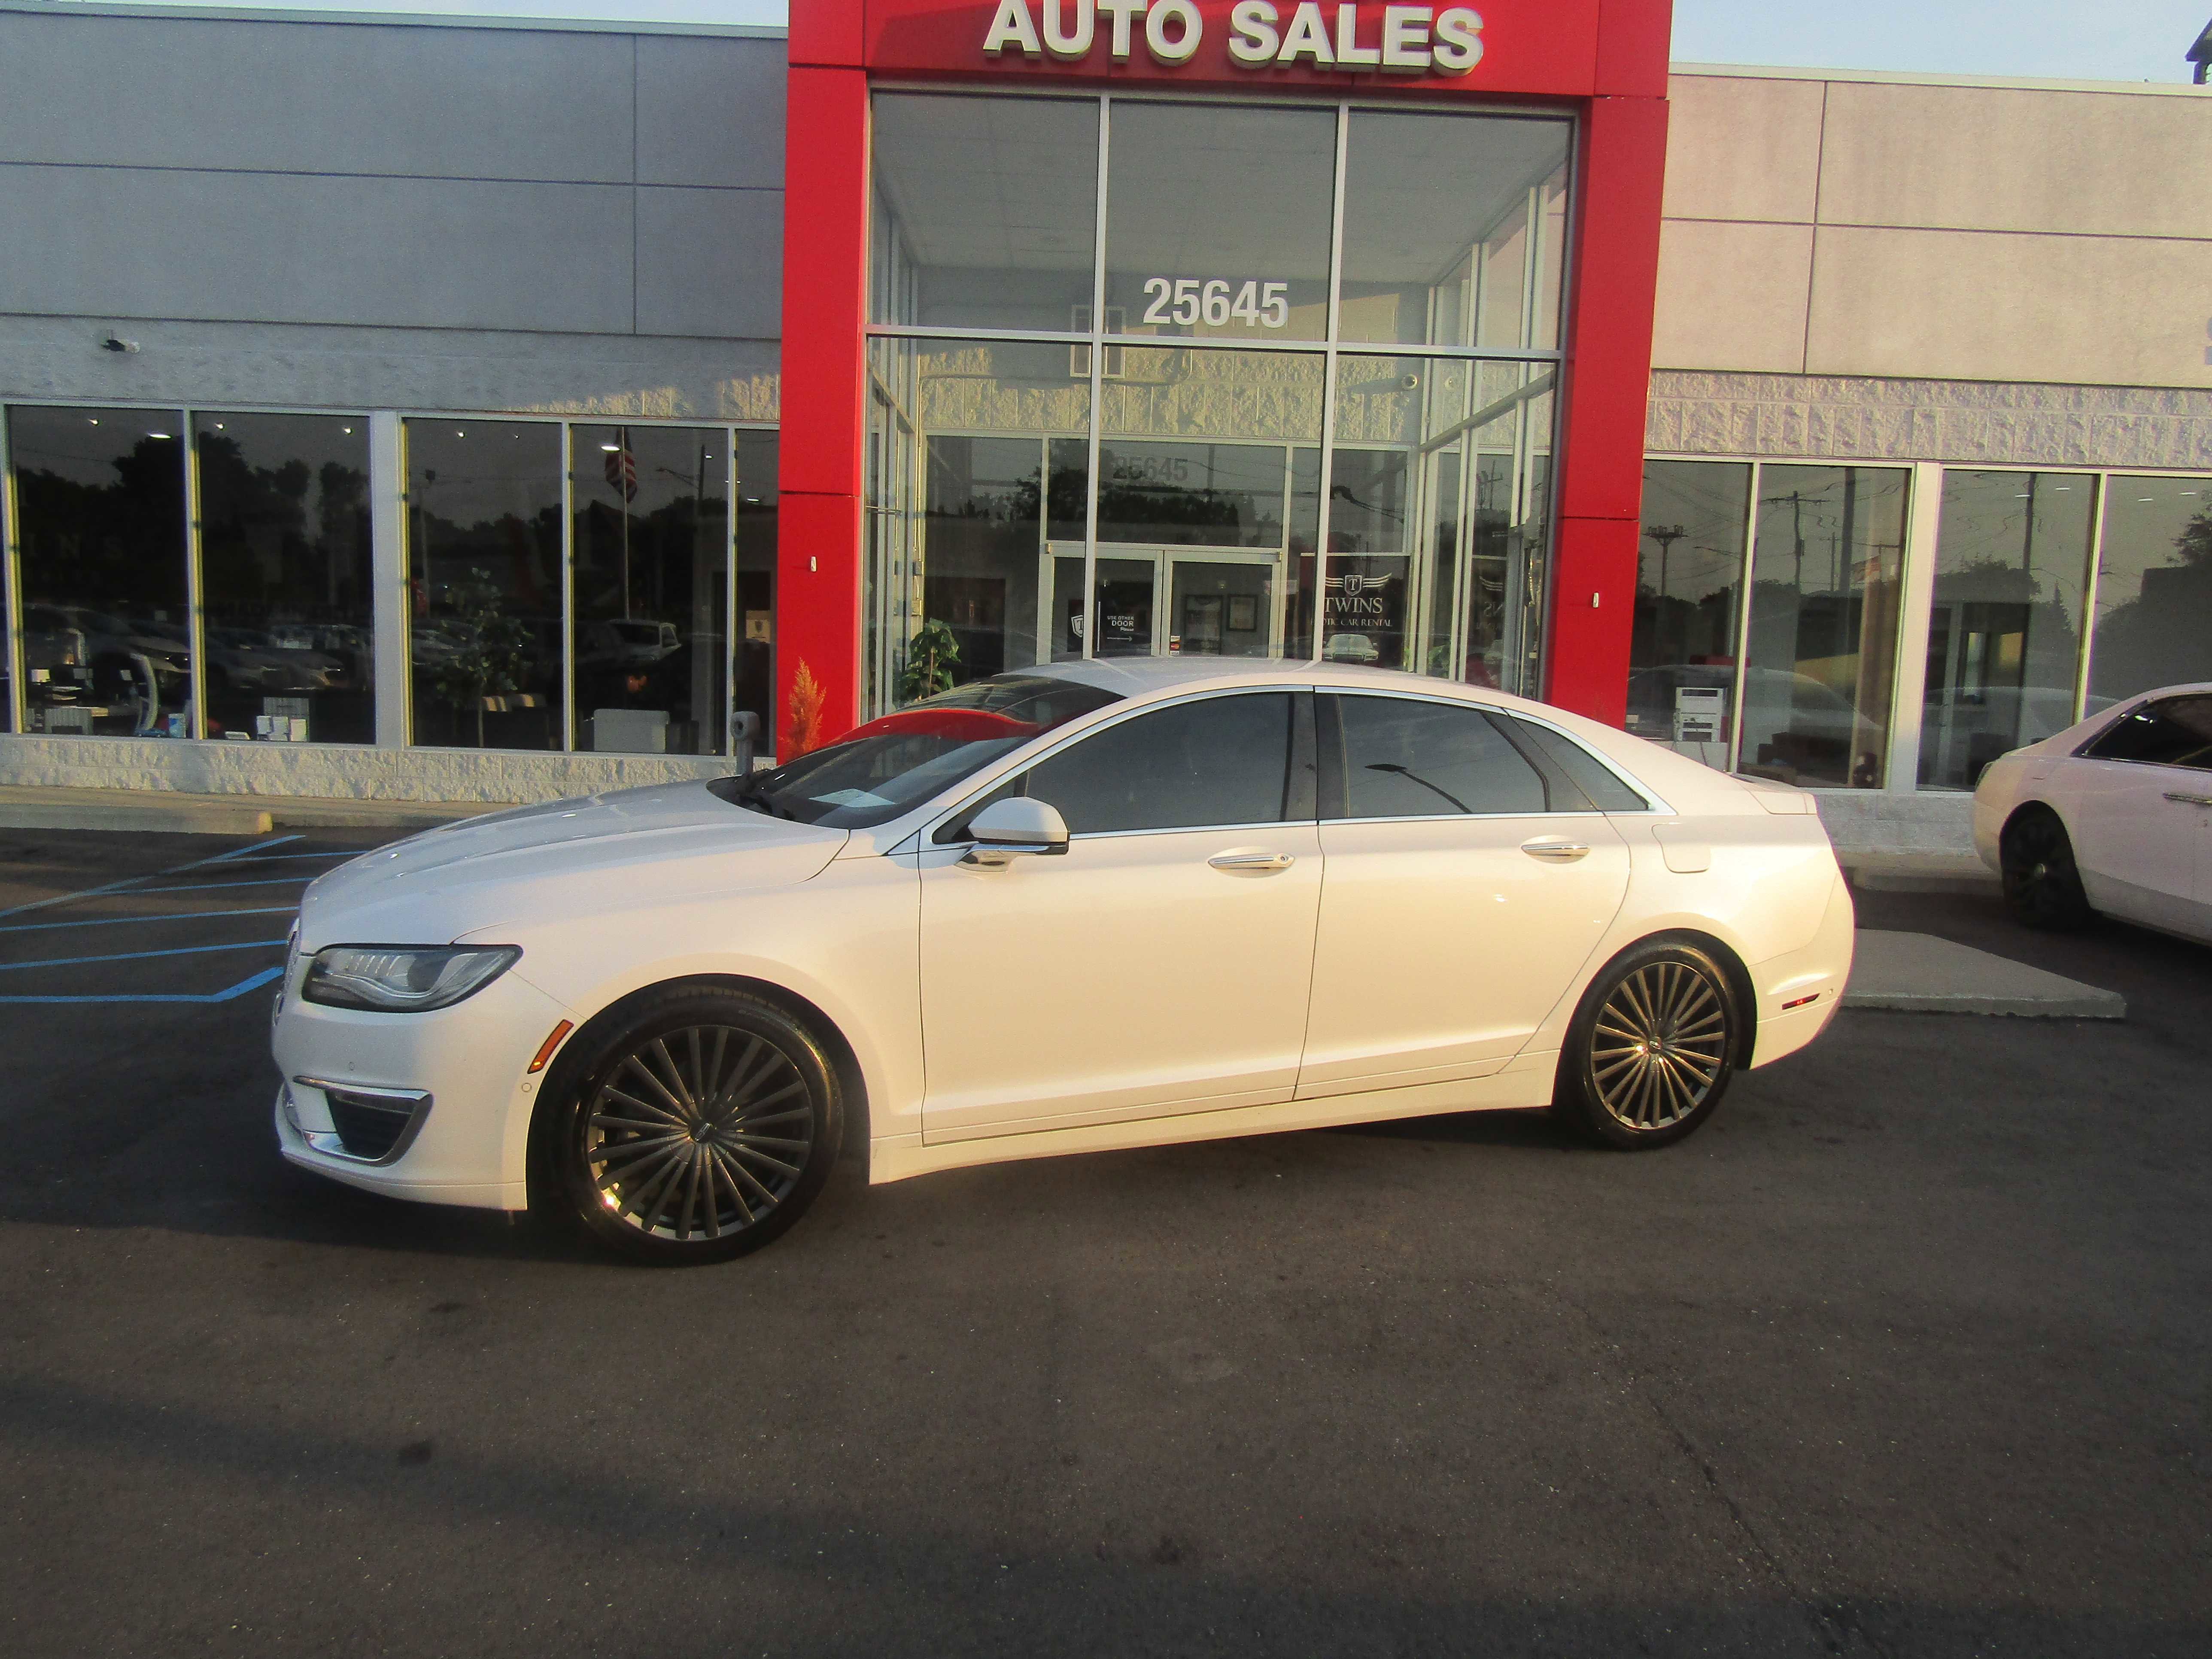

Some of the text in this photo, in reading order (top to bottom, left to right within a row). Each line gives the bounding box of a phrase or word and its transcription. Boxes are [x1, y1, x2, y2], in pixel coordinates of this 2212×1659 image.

[983, 0, 1484, 73] AUTO SALES
[1142, 277, 1288, 328] 25645
[1325, 597, 1383, 614] TWINS
[1340, 618, 1358, 626] CAR
[1361, 619, 1393, 627] RENTAL
